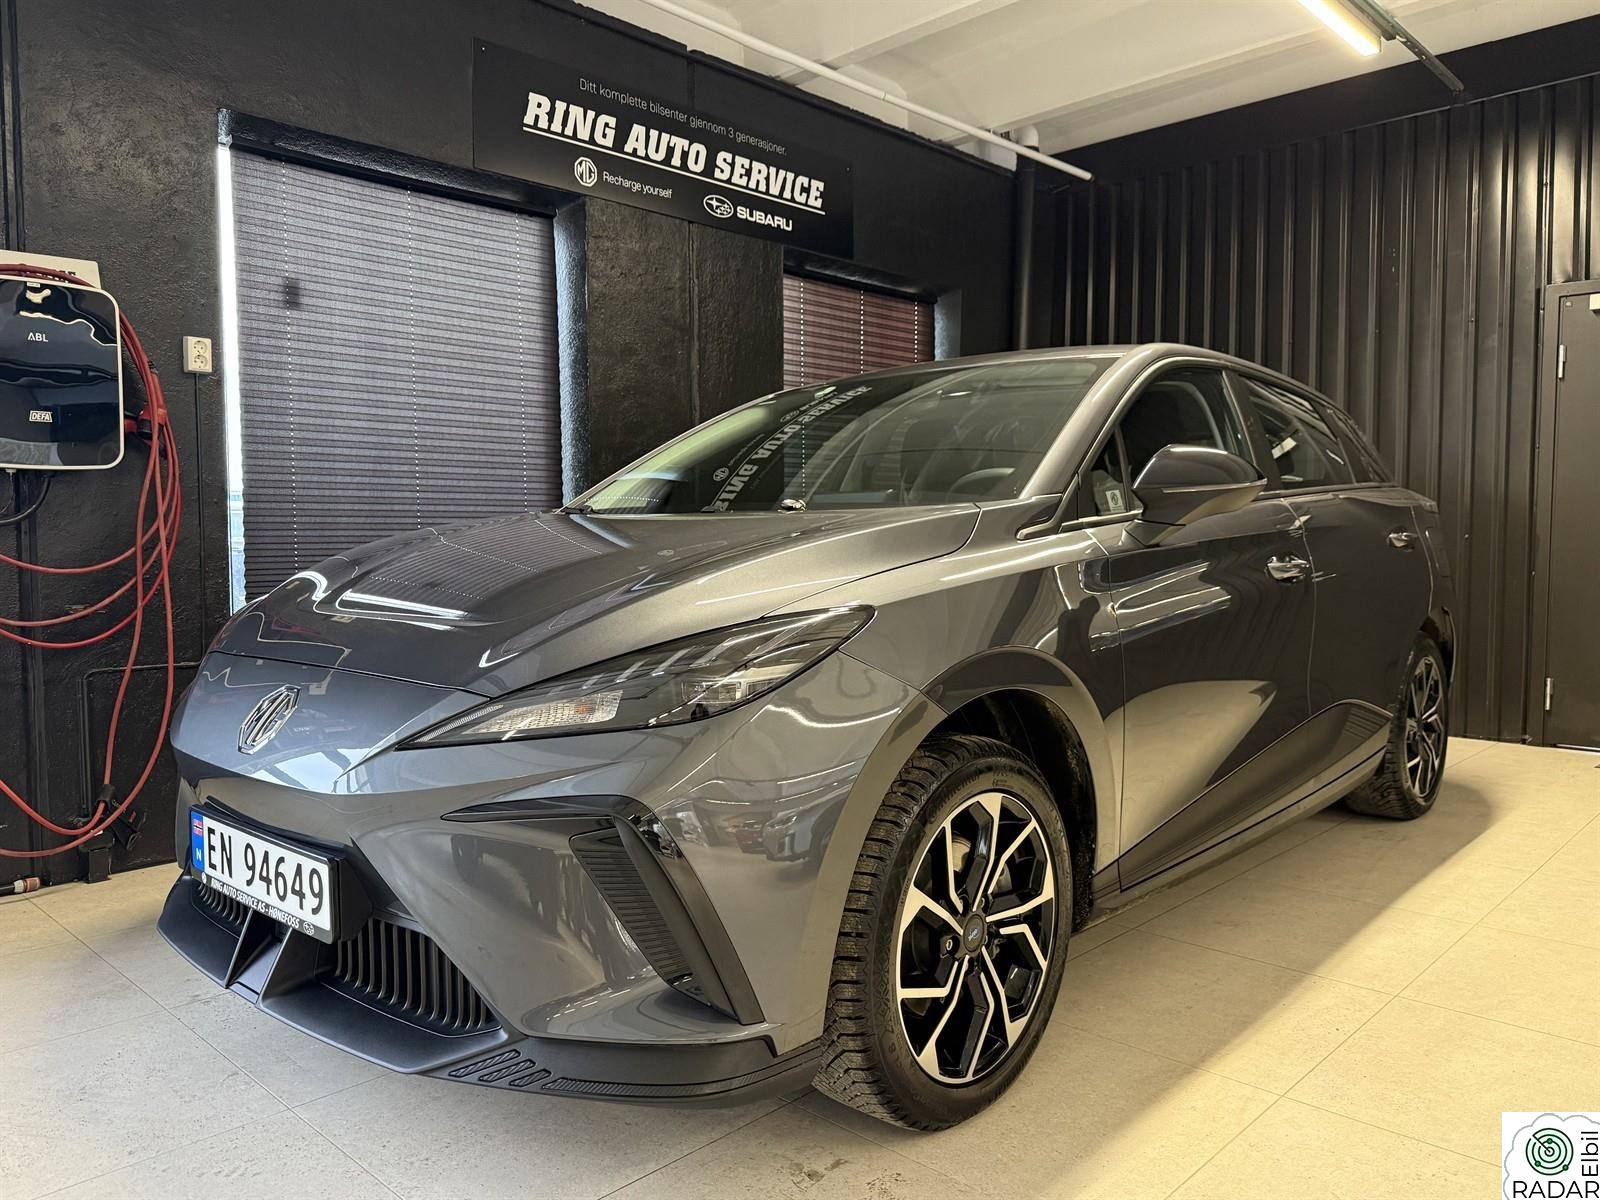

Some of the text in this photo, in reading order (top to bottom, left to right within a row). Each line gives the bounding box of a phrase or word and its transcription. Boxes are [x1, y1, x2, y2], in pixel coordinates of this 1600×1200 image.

[579, 79, 596, 95] Ditt
[600, 84, 647, 110] komplette
[650, 101, 687, 122] bilsenter
[690, 116, 726, 136] gjennom
[729, 128, 734, 138] 3
[523, 91, 825, 208] RING AUTO SERVICE
[576, 159, 596, 184] MG
[603, 171, 673, 199] Recharge yourself
[736, 206, 793, 231] SUBARU
[27, 332, 49, 343] ABL
[31, 411, 51, 421] DEFA
[190, 847, 202, 861] N
[207, 826, 324, 915] EN 94649
[223, 882, 237, 900] AUTO
[236, 892, 258, 909] SERVICE
[257, 900, 266, 913] AS
